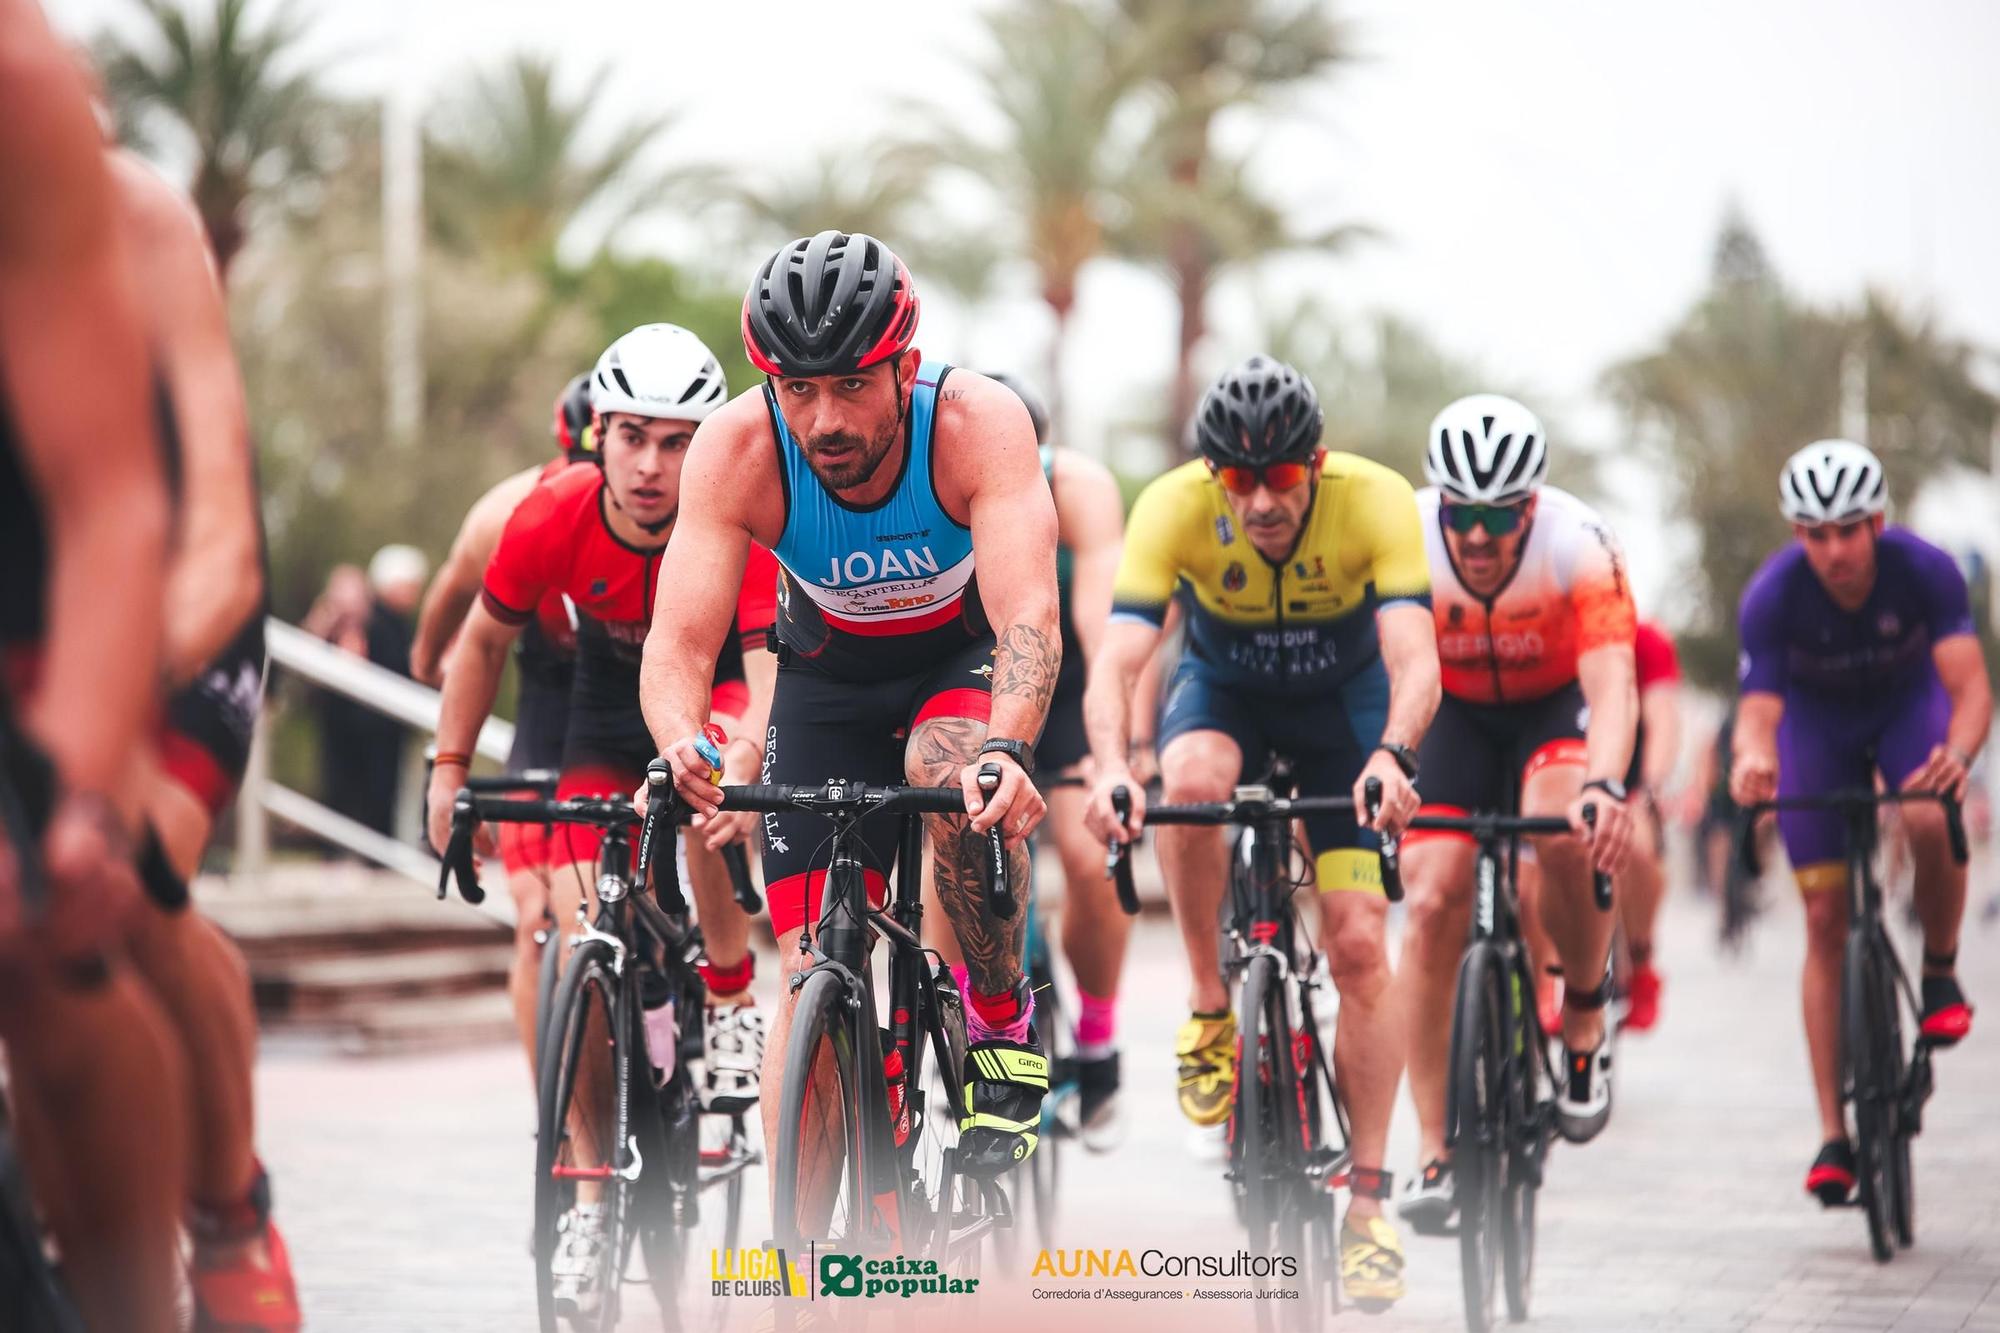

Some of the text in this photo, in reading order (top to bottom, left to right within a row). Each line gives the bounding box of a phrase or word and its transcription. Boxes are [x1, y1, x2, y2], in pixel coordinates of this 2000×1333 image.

[820, 546, 940, 587] JOAN
[823, 579, 936, 600] CECANTELLA
[640, 814, 655, 869] ULTEGRA
[1018, 1057, 1043, 1070] GIRO
